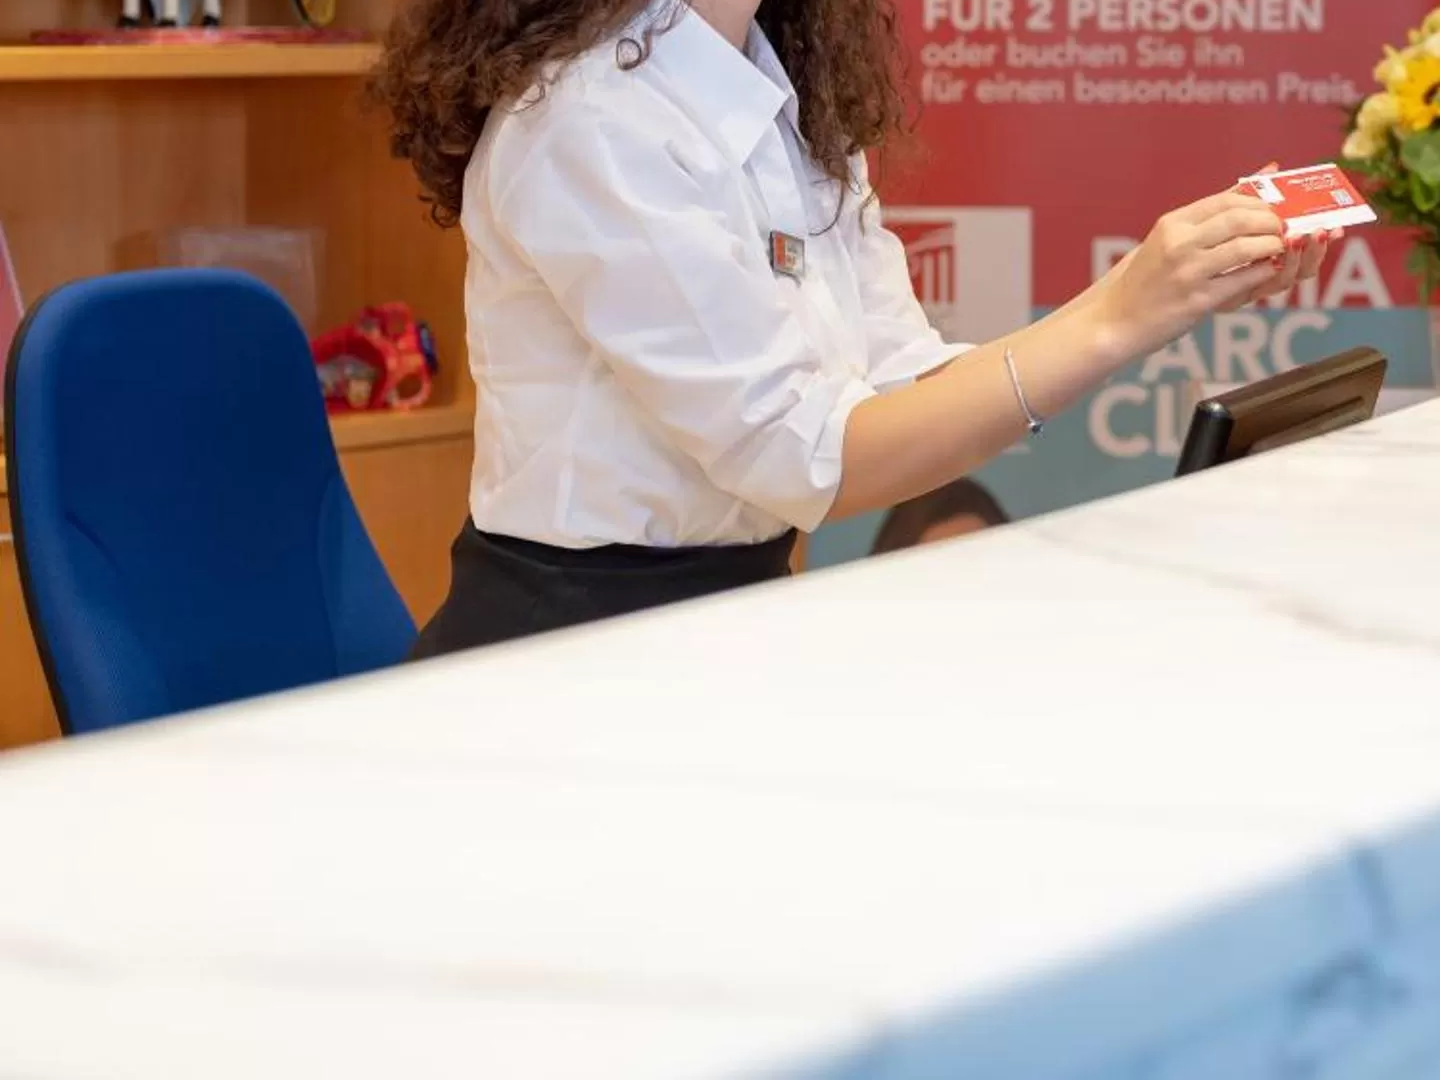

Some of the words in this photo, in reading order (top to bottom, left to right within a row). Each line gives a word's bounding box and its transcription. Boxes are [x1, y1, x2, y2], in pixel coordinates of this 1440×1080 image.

[920, 36, 996, 67] oder
[1007, 36, 1127, 67] buchen
[1136, 37, 1186, 68] Sie
[1195, 37, 1244, 67] ihn
[920, 73, 967, 103] für
[975, 75, 1066, 103] einen
[1074, 73, 1269, 104] besonderen
[1141, 311, 1332, 383] ARC
